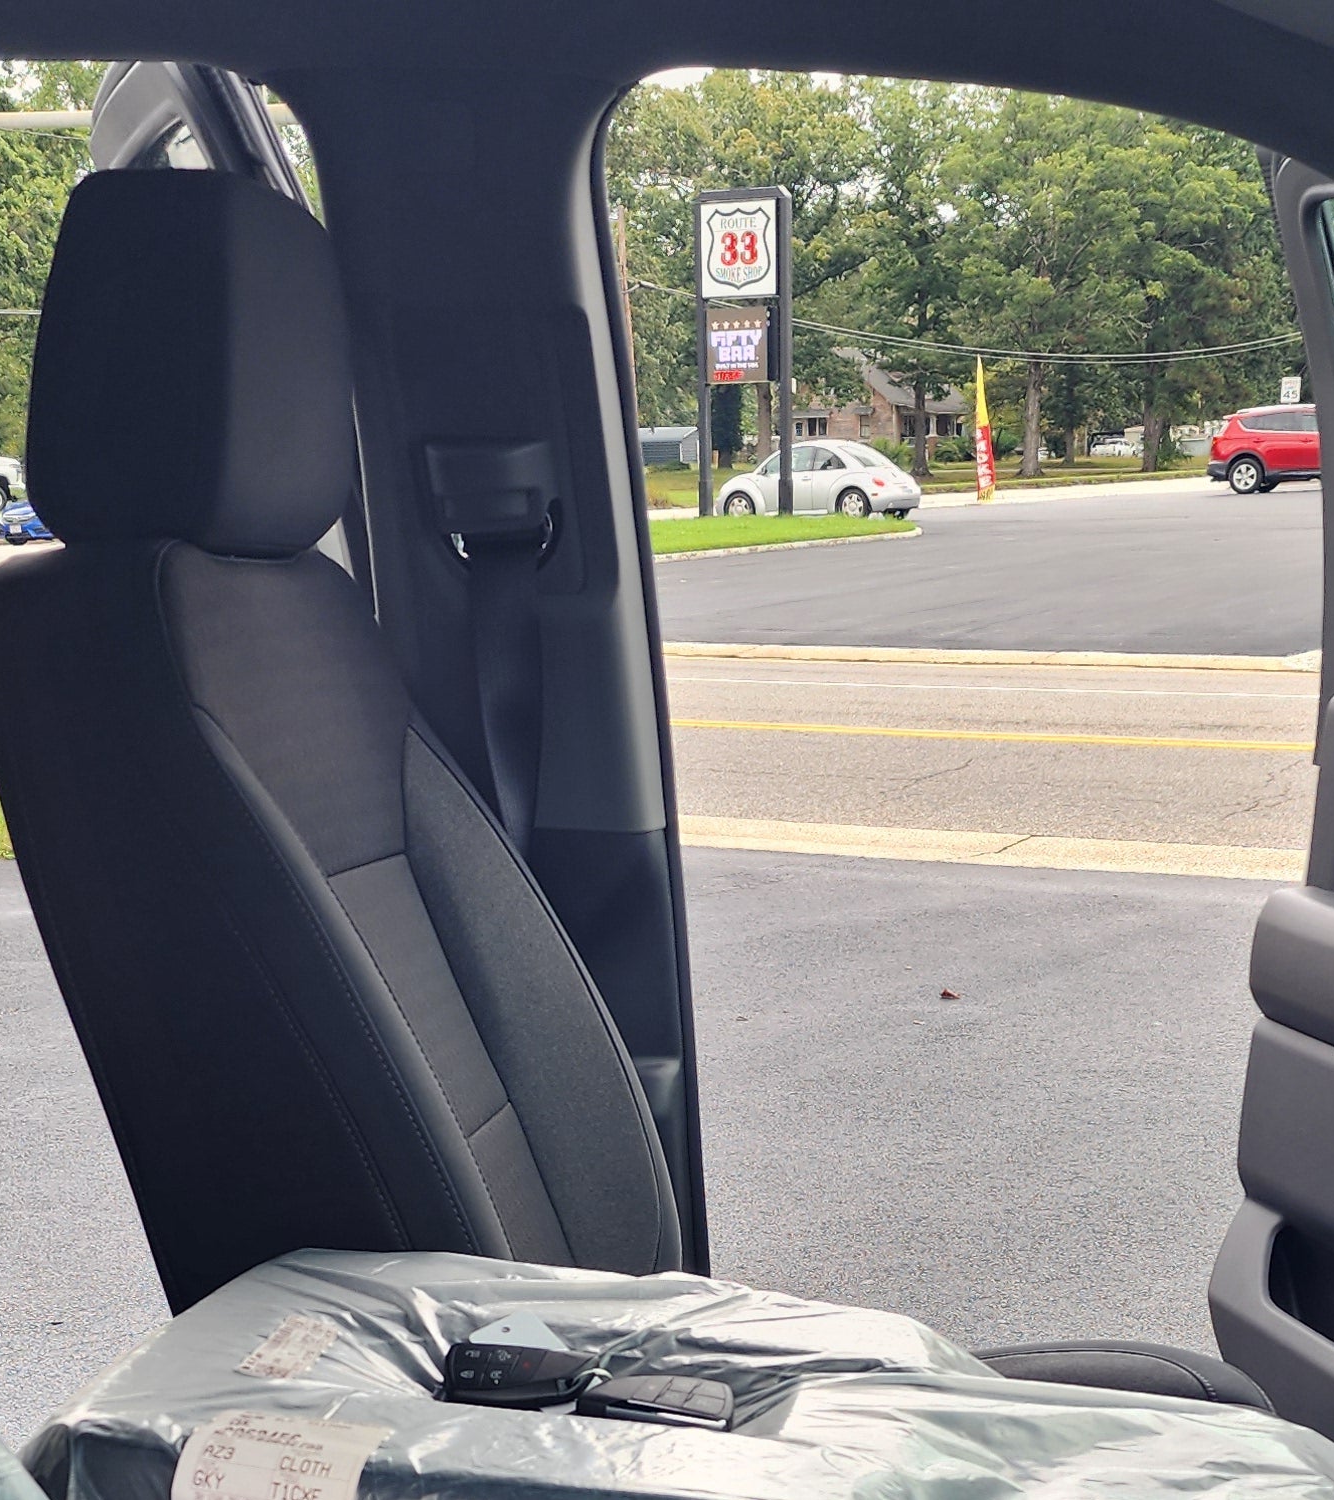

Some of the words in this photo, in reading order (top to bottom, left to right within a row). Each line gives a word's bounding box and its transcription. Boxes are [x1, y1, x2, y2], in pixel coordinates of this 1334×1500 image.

[720, 216, 757, 230] ROUTE
[720, 230, 758, 266] 33
[715, 266, 742, 283] SMOKE
[742, 265, 763, 281] SHOP
[1282, 389, 1299, 400] 45
[202, 1444, 236, 1460] AZ3
[278, 1455, 332, 1478] CLOTH
[192, 1468, 227, 1491] GKY
